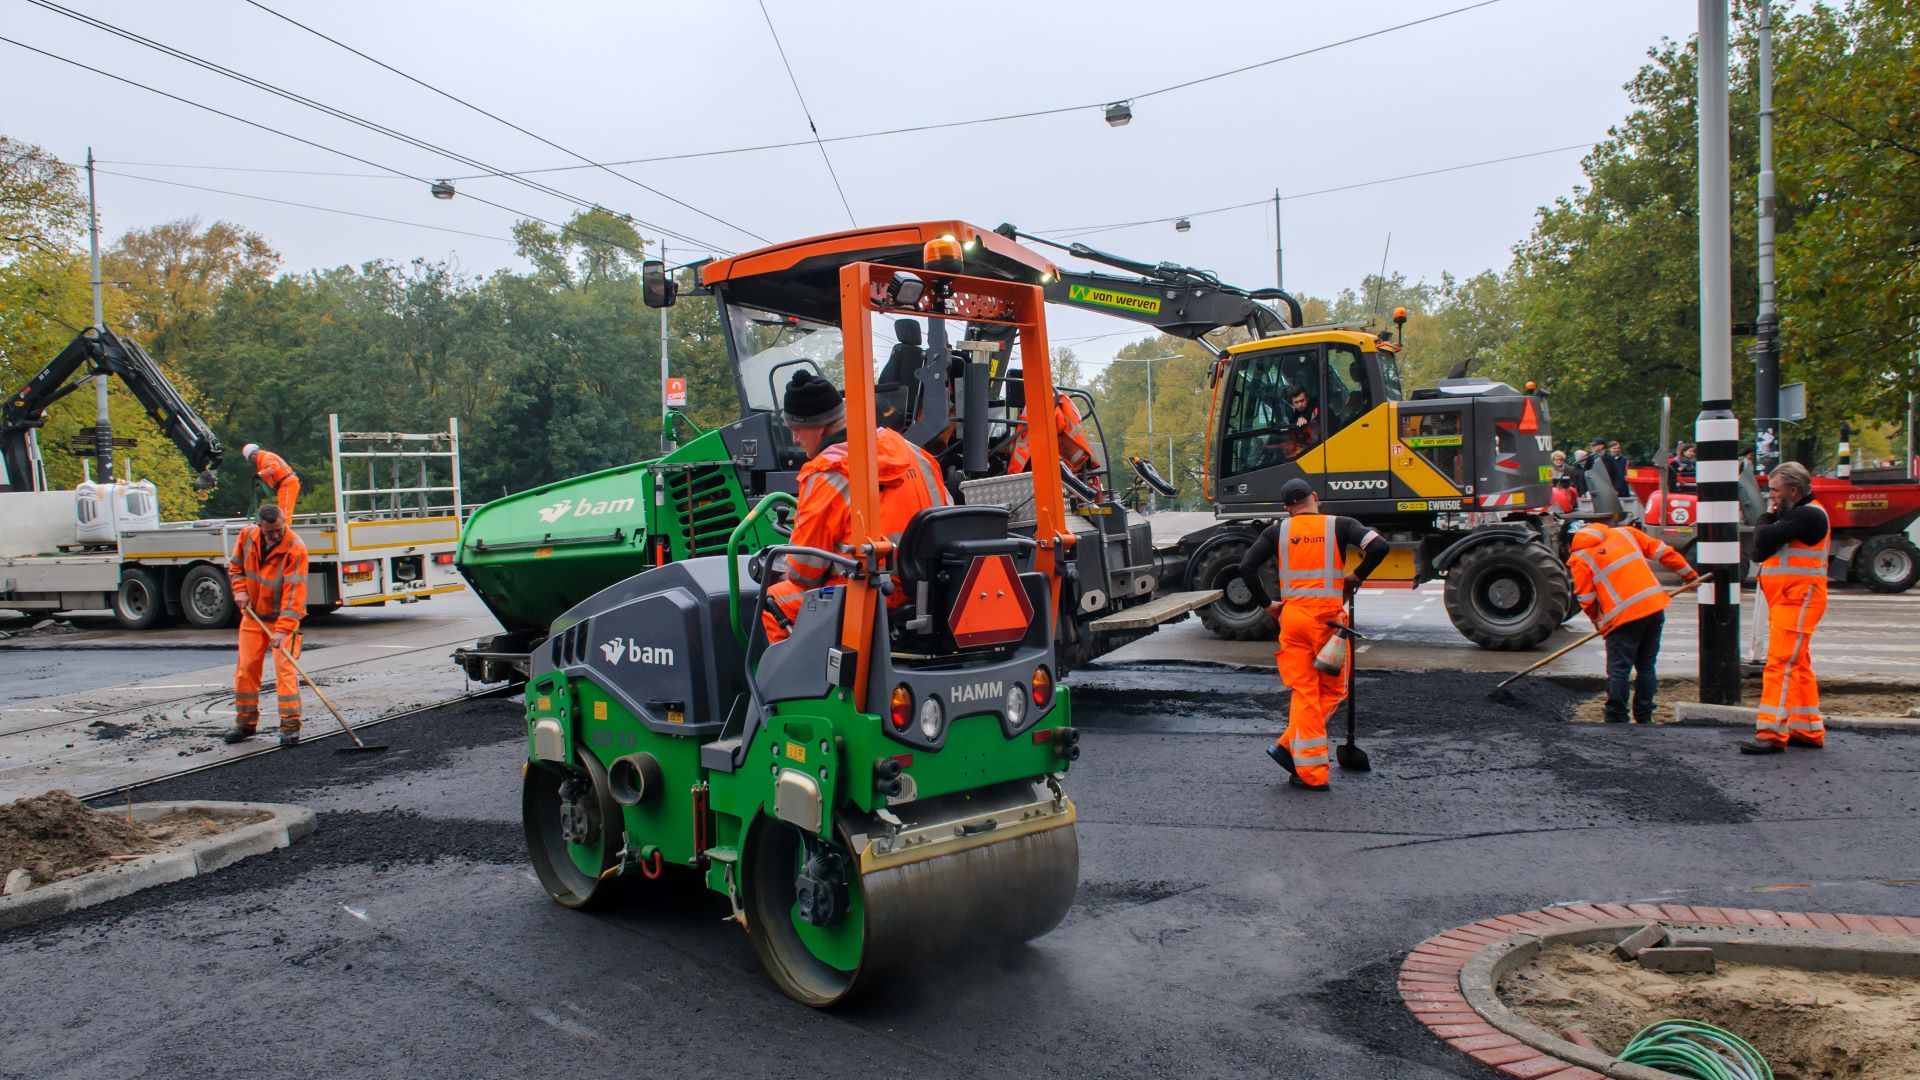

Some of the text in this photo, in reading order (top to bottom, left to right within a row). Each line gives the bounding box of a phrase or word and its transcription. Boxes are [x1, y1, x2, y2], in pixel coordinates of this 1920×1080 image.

[1093, 291, 1157, 310] van werven
[668, 391, 686, 400] coop
[1328, 480, 1388, 491] VOLVO
[573, 498, 635, 517] bam
[1428, 500, 1461, 510] EWR150E
[1675, 510, 1686, 521] 25
[1303, 536, 1326, 544] bam
[629, 638, 674, 666] bam
[951, 680, 1003, 703] HAMM
